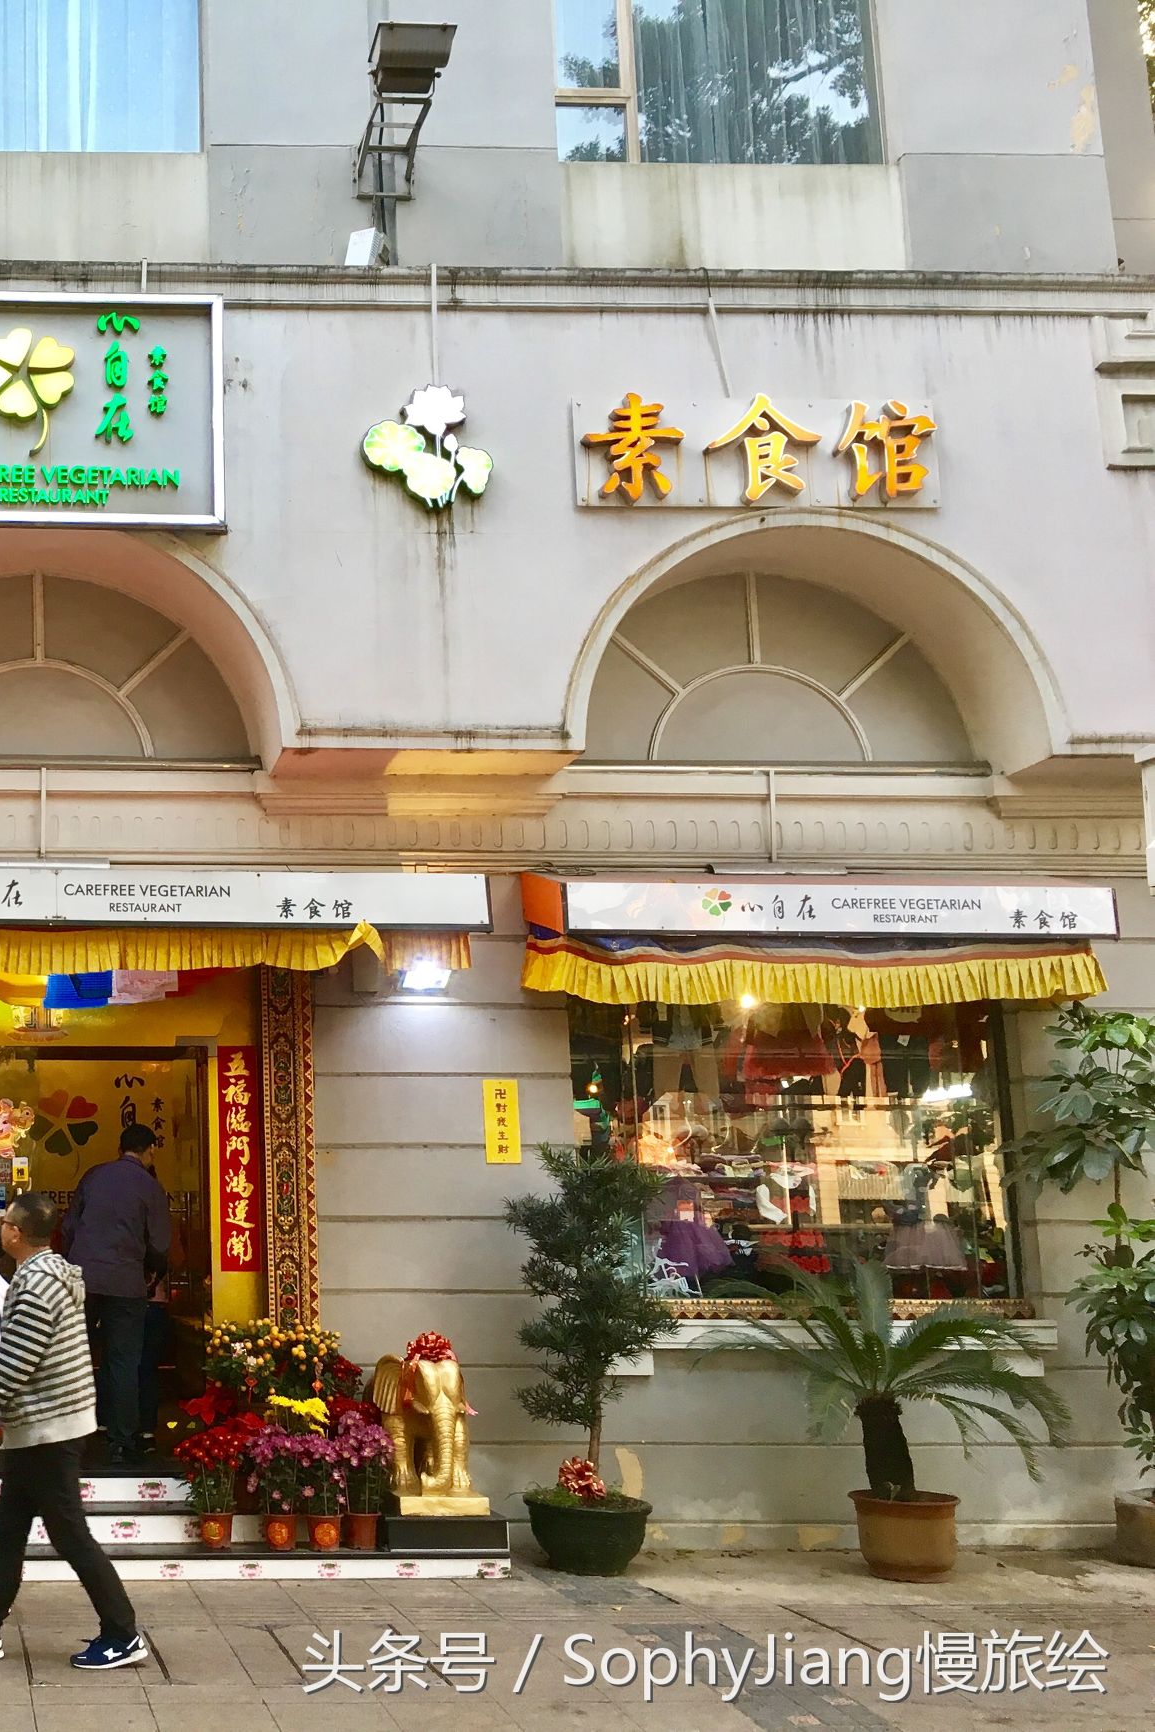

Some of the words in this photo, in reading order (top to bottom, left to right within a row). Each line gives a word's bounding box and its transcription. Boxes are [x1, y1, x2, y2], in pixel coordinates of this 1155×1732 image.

[147, 344, 170, 416] 素食馆
[580, 392, 938, 505] 素食馆
[40, 465, 181, 489] VEGETARIAN
[63, 883, 135, 897] CAREFREE
[139, 885, 231, 898] VEGETARIAN
[109, 902, 182, 913] RESTAURANT
[276, 897, 353, 920] 素食馆
[740, 894, 817, 921] 心自在
[831, 897, 896, 910] CAREFREE
[899, 898, 982, 911] VEGETARIAN
[873, 914, 938, 924] RESTAURANT
[1009, 908, 1078, 930] 素食馆
[114, 1072, 145, 1128] 心自
